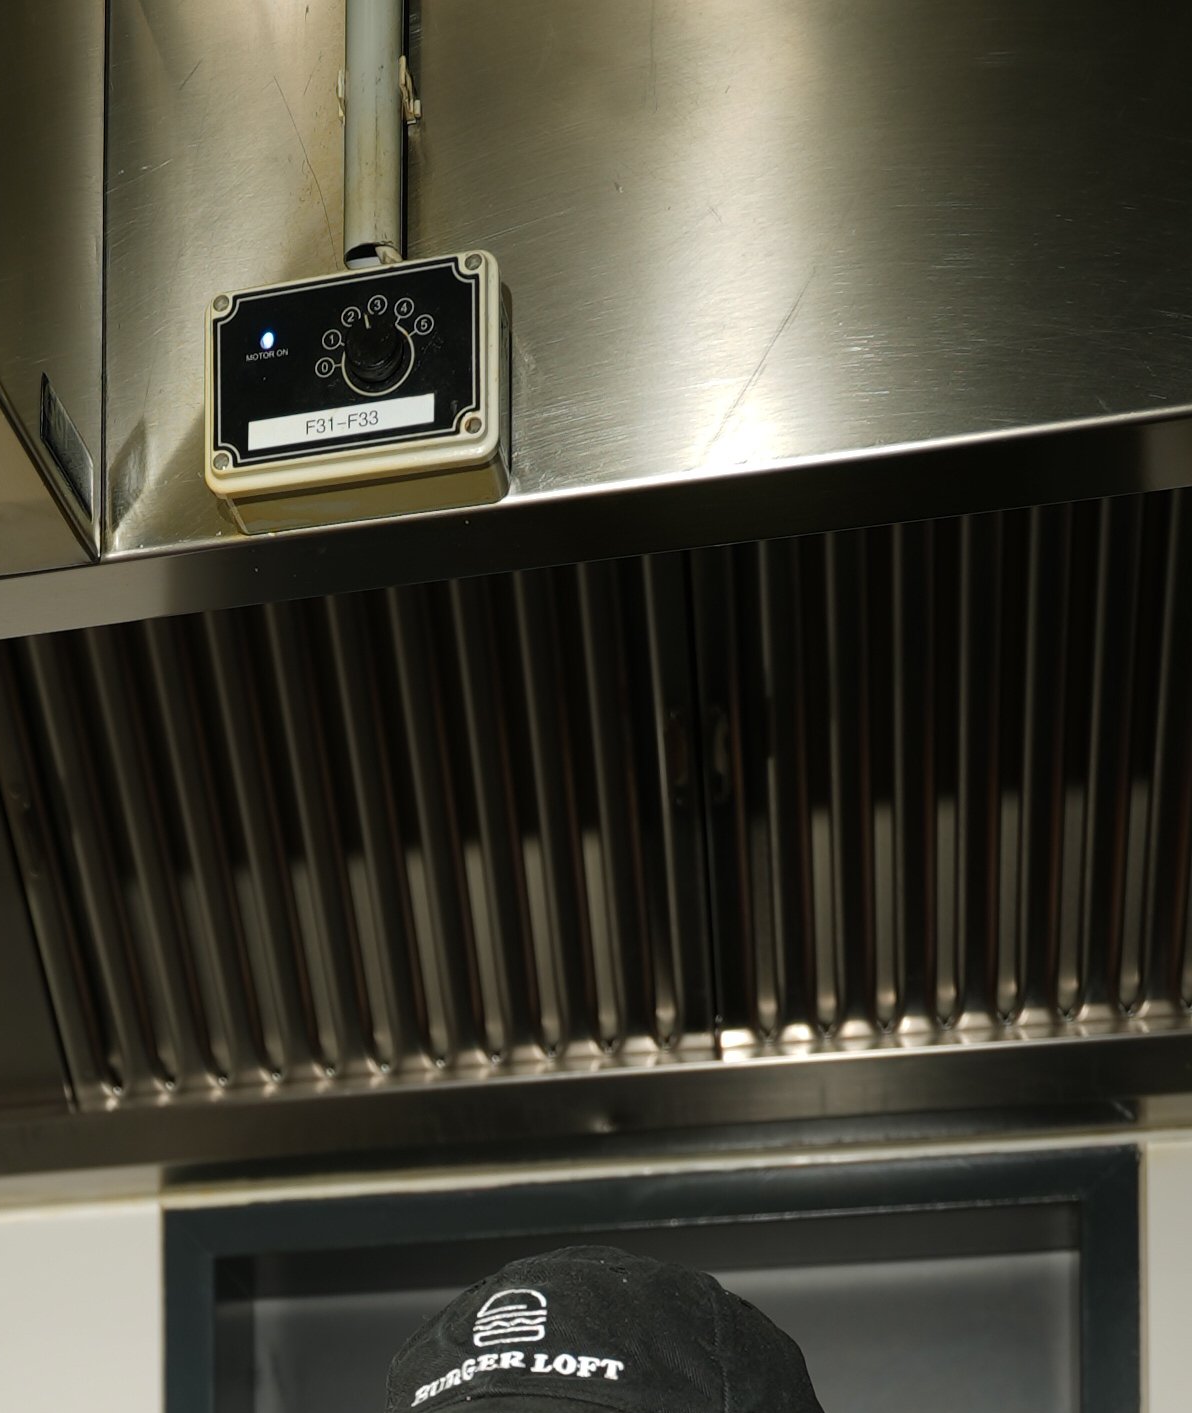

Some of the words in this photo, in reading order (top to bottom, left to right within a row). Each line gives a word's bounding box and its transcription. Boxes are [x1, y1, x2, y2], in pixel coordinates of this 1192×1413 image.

[373, 299, 381, 311] 3
[400, 302, 408, 313] 4
[347, 311, 355, 323] 2
[420, 319, 428, 330] 5
[245, 350, 275, 362] MOTOR
[276, 348, 289, 357] ON
[321, 362, 329, 373] 0
[305, 410, 379, 435] F31-F33
[411, 1351, 526, 1407] BURGER
[530, 1353, 624, 1380] LOFT
